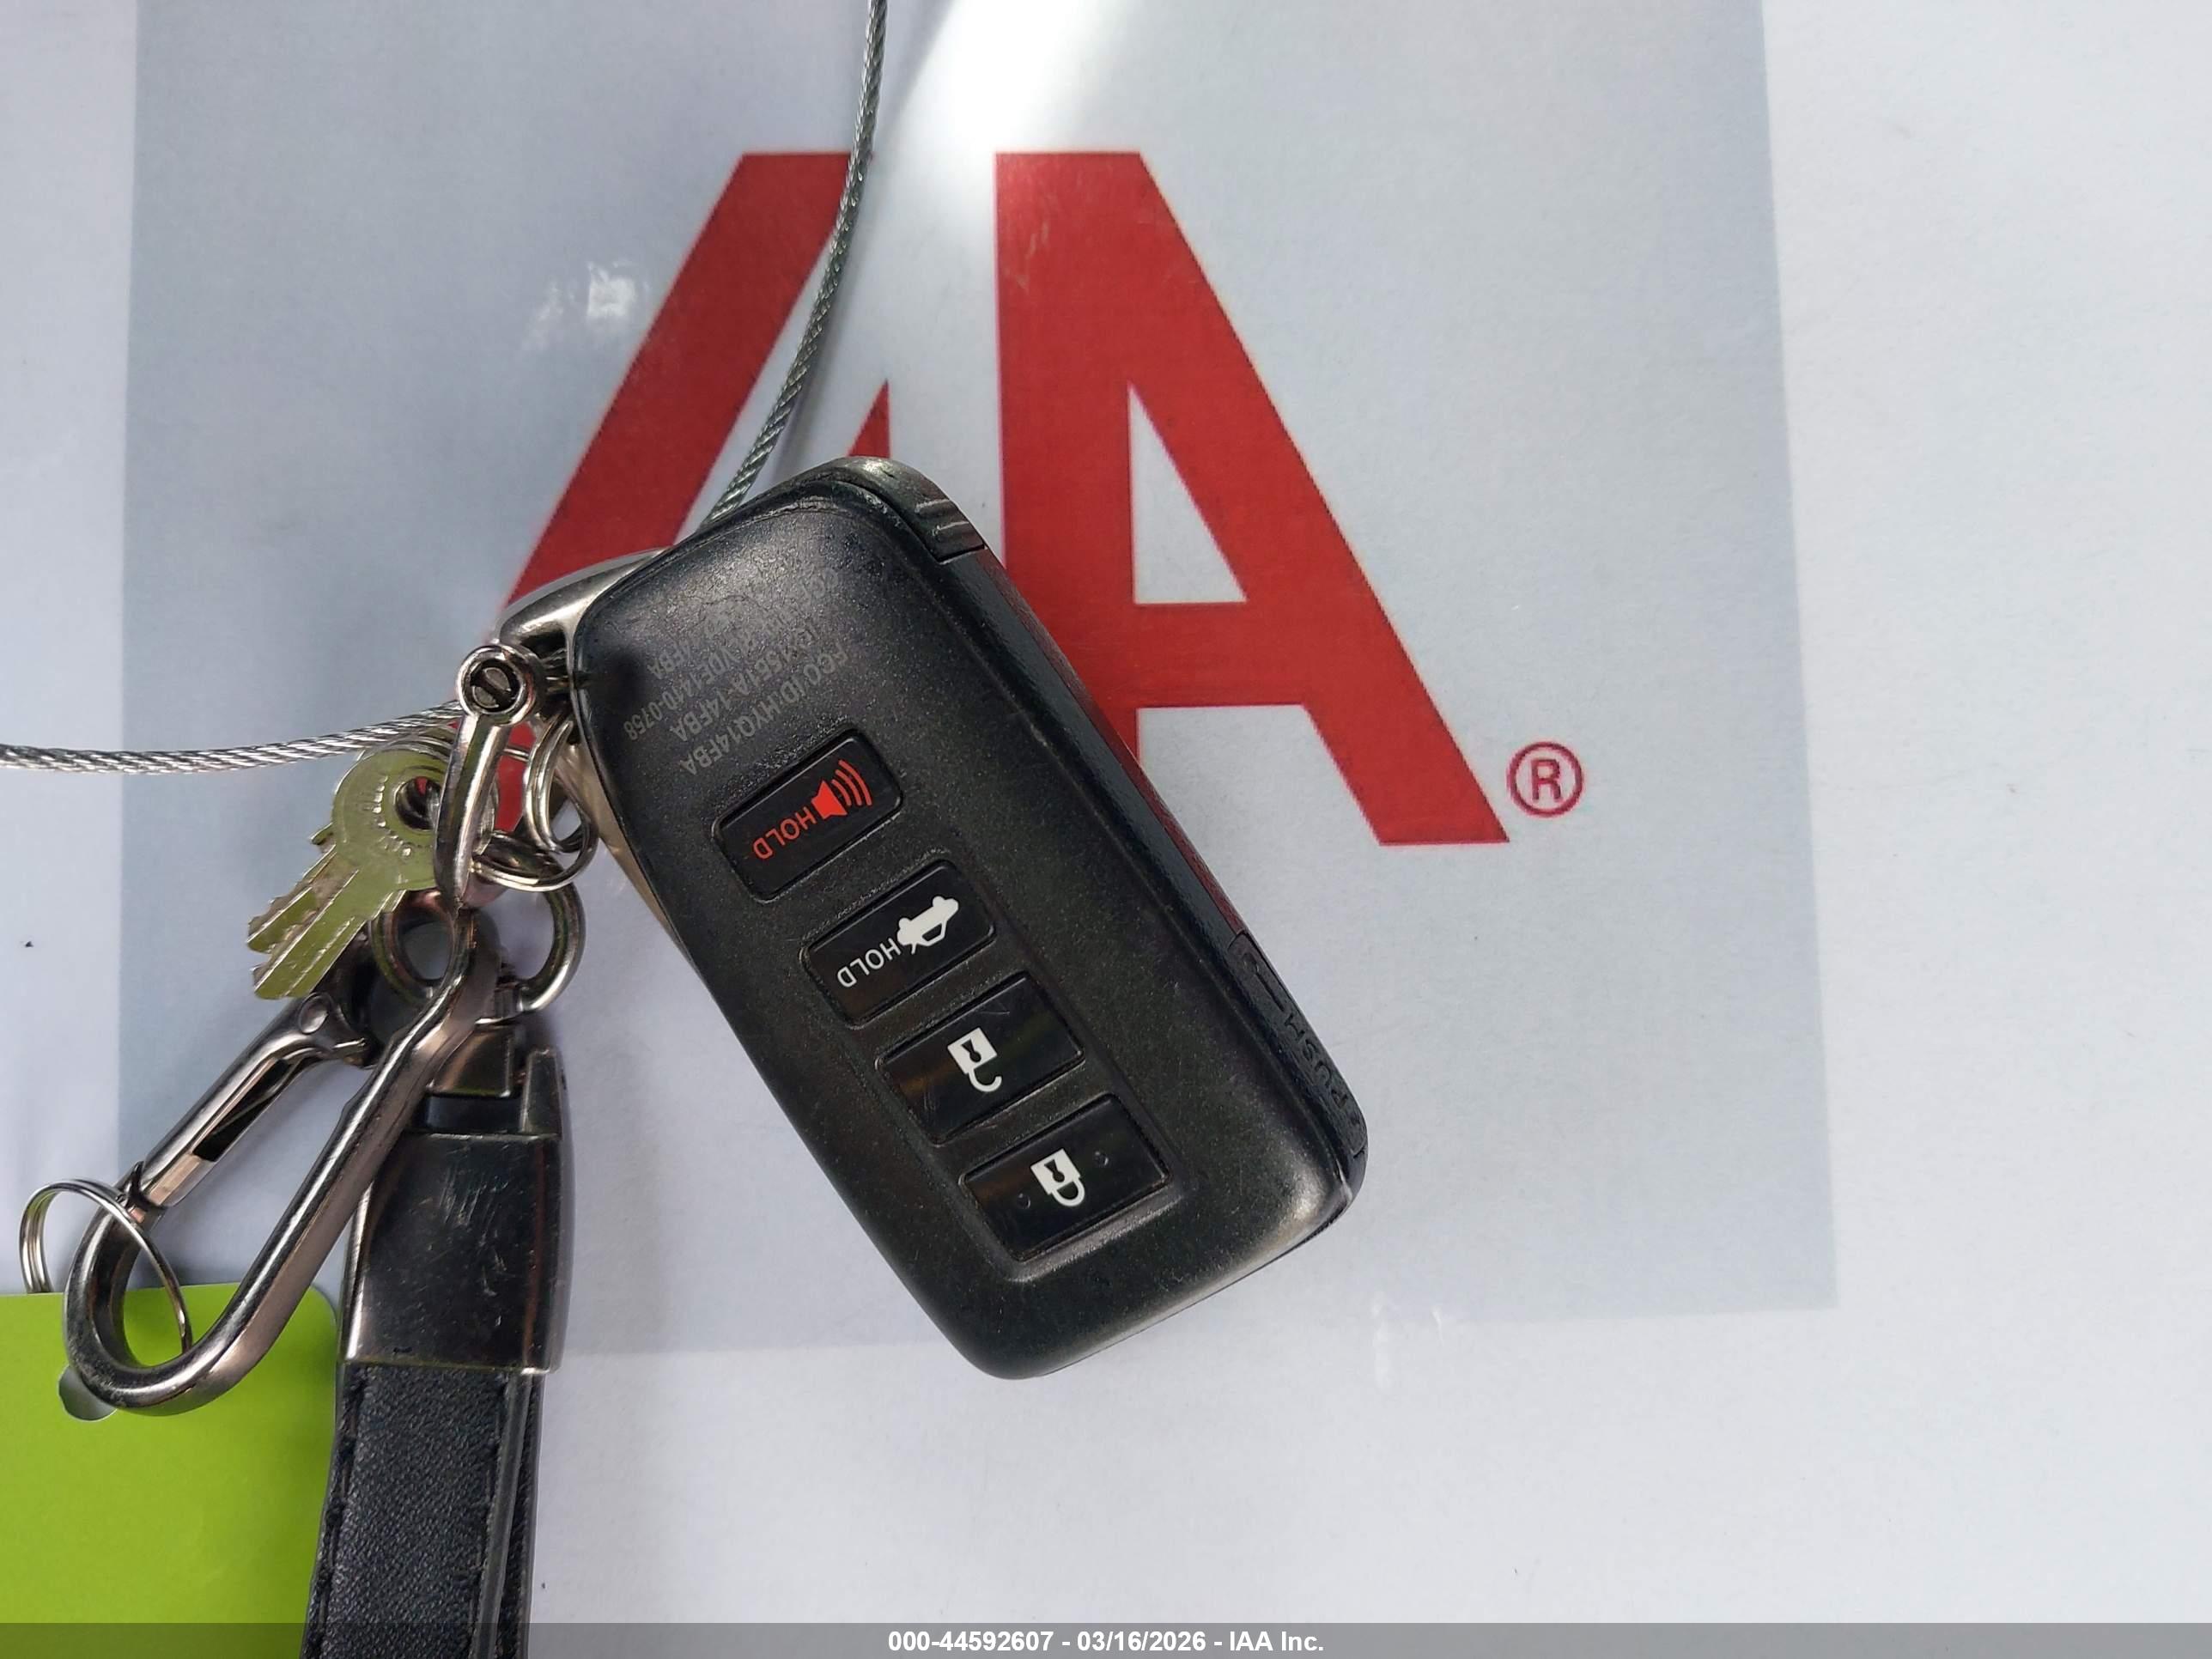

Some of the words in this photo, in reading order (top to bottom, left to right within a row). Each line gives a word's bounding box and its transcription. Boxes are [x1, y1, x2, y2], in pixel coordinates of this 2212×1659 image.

[752, 806, 816, 860] HOLD
[836, 938, 902, 988] HOLD
[1284, 1013, 1350, 1108] PUSH
